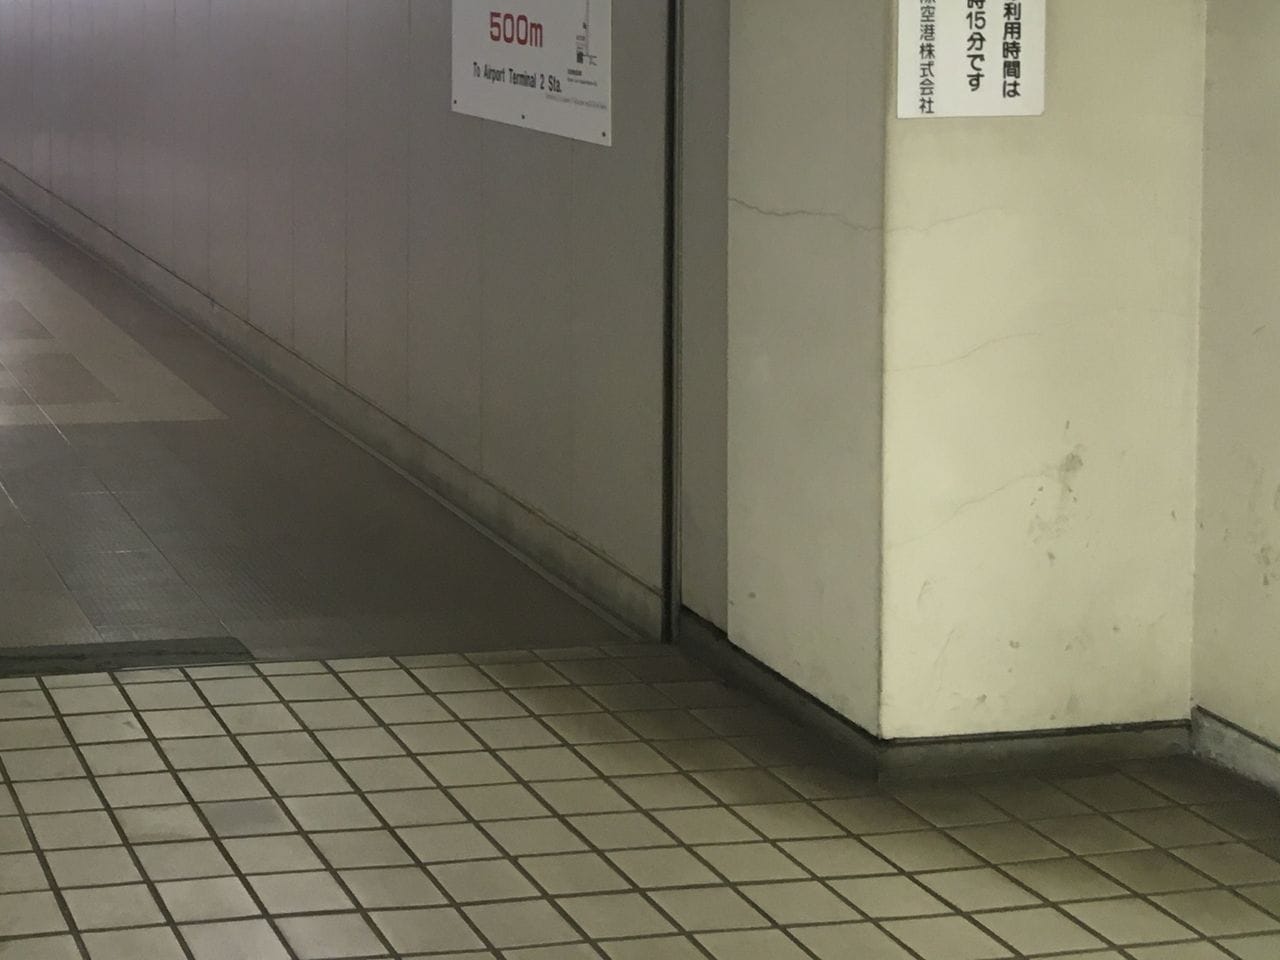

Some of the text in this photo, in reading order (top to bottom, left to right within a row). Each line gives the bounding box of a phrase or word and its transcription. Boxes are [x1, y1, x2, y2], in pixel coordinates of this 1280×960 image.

[490, 11, 543, 48] 500m
[473, 61, 481, 78] To
[483, 64, 506, 83] Airport
[509, 68, 537, 89] Terminal
[540, 73, 545, 90] 2
[548, 74, 562, 93] Sta.
